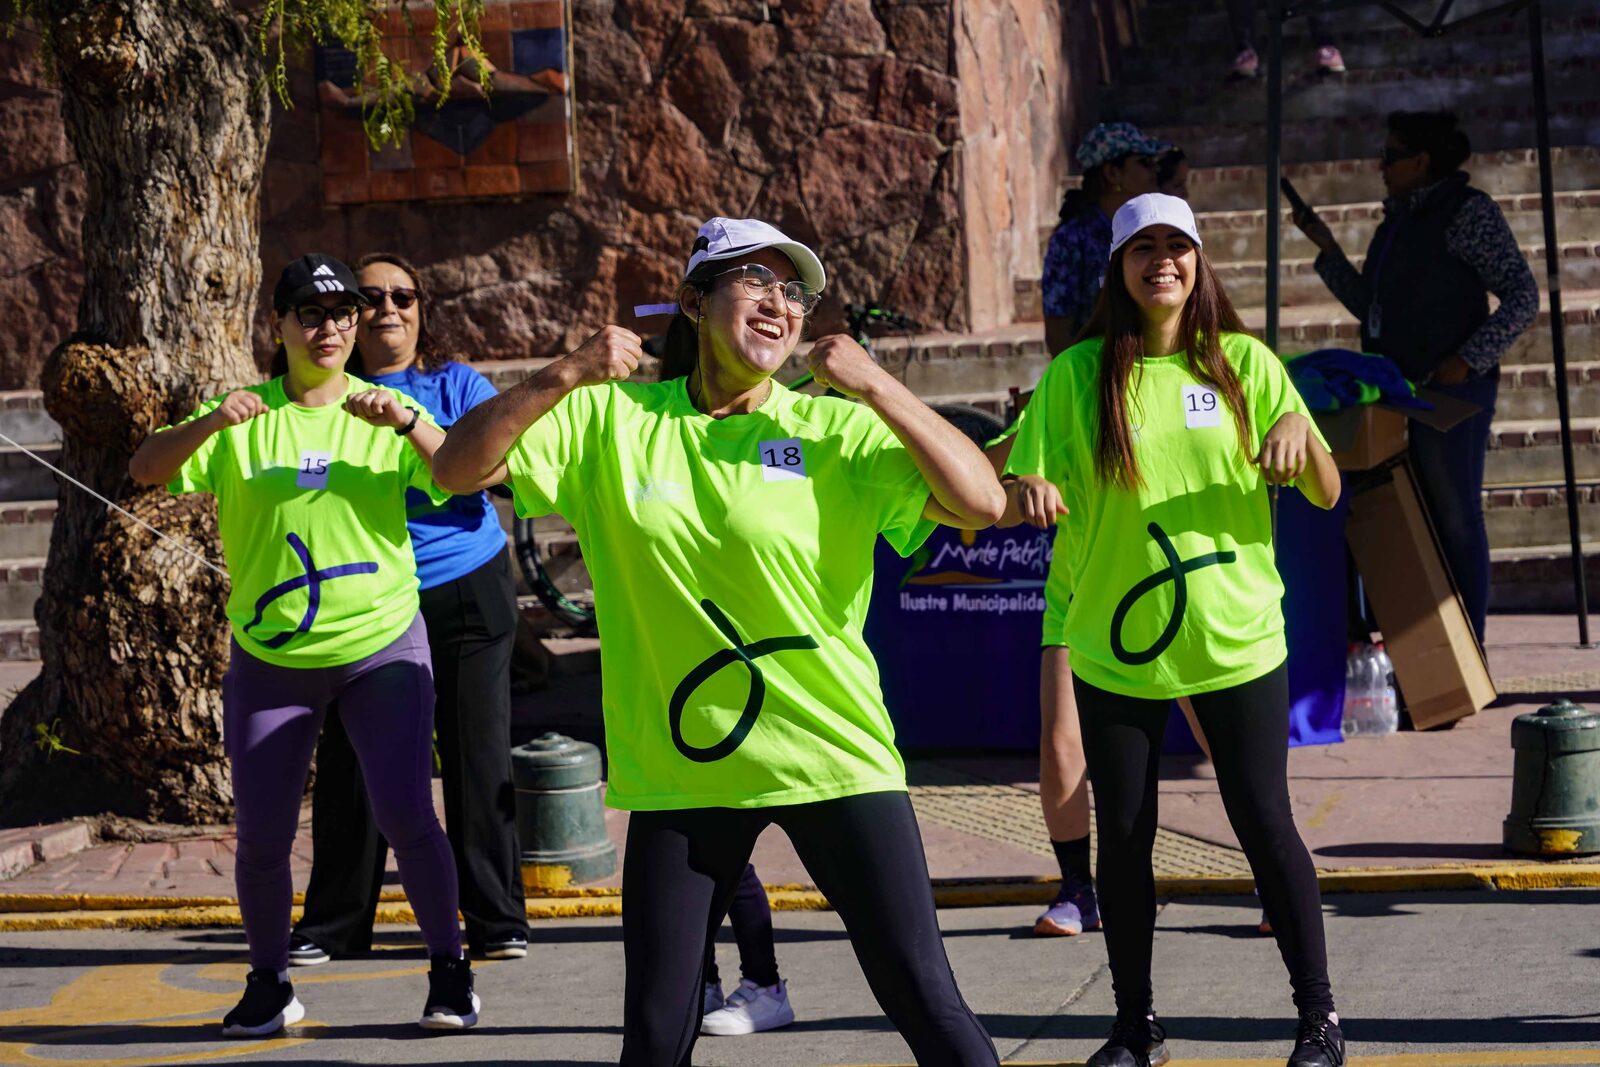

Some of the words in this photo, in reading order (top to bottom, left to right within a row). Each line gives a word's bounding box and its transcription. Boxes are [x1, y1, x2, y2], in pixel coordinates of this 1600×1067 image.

[1186, 392, 1217, 412] 19
[301, 457, 328, 475] 15
[764, 446, 802, 468] 18
[930, 540, 999, 569] Monte
[900, 592, 948, 612] Ilustre
